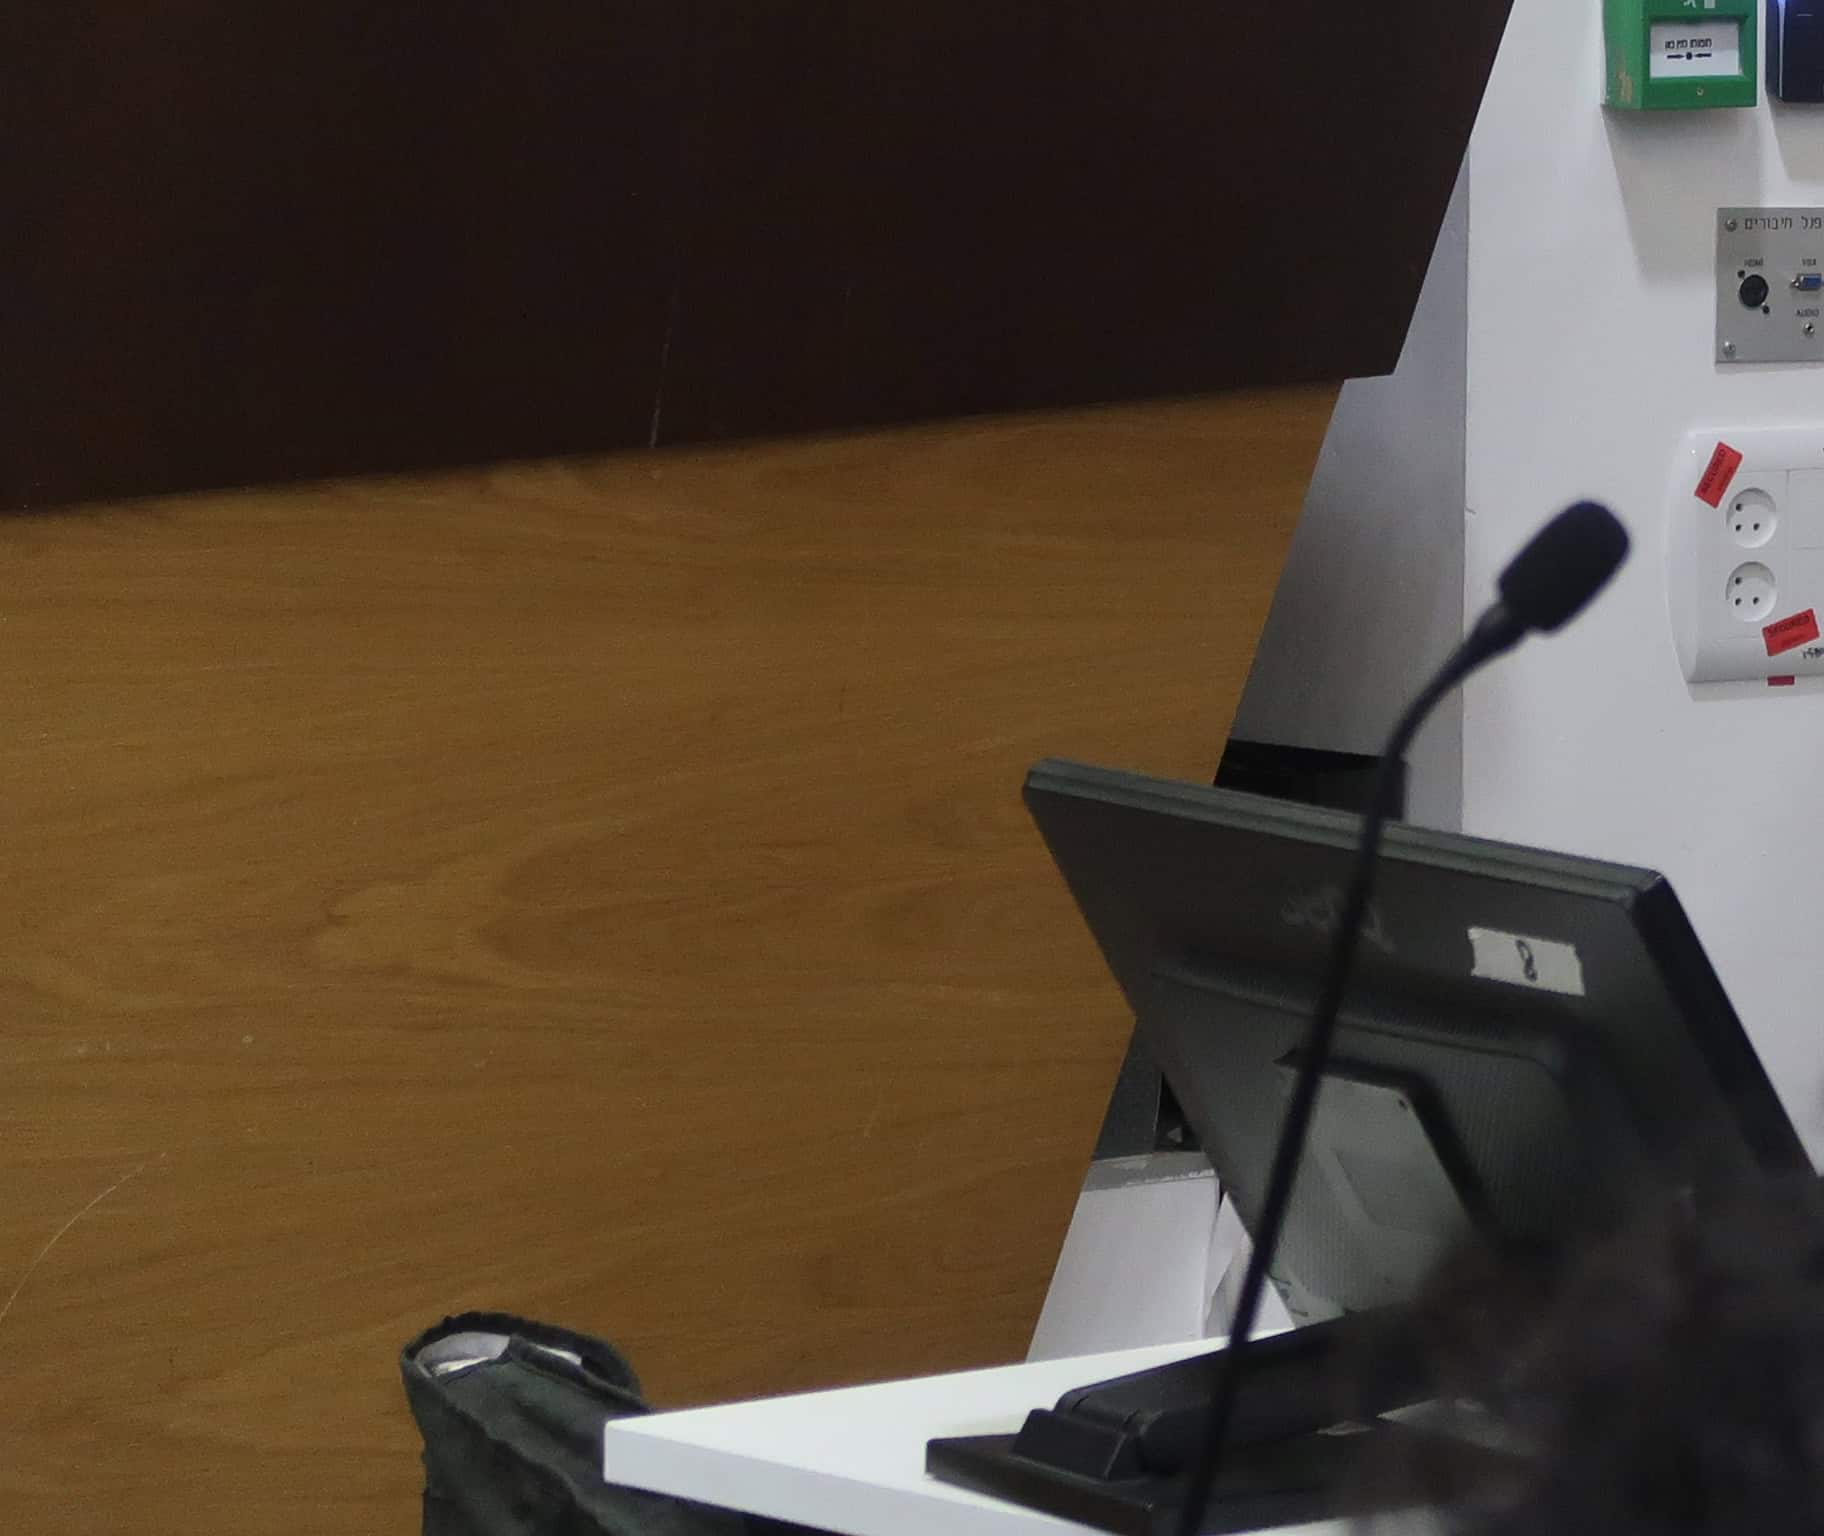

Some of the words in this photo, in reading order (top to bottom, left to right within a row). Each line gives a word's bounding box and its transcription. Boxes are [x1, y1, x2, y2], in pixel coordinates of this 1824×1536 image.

[1744, 217, 1793, 230] חיבורים
[1800, 216, 1823, 230] פנל
[1516, 939, 1538, 982] 8
